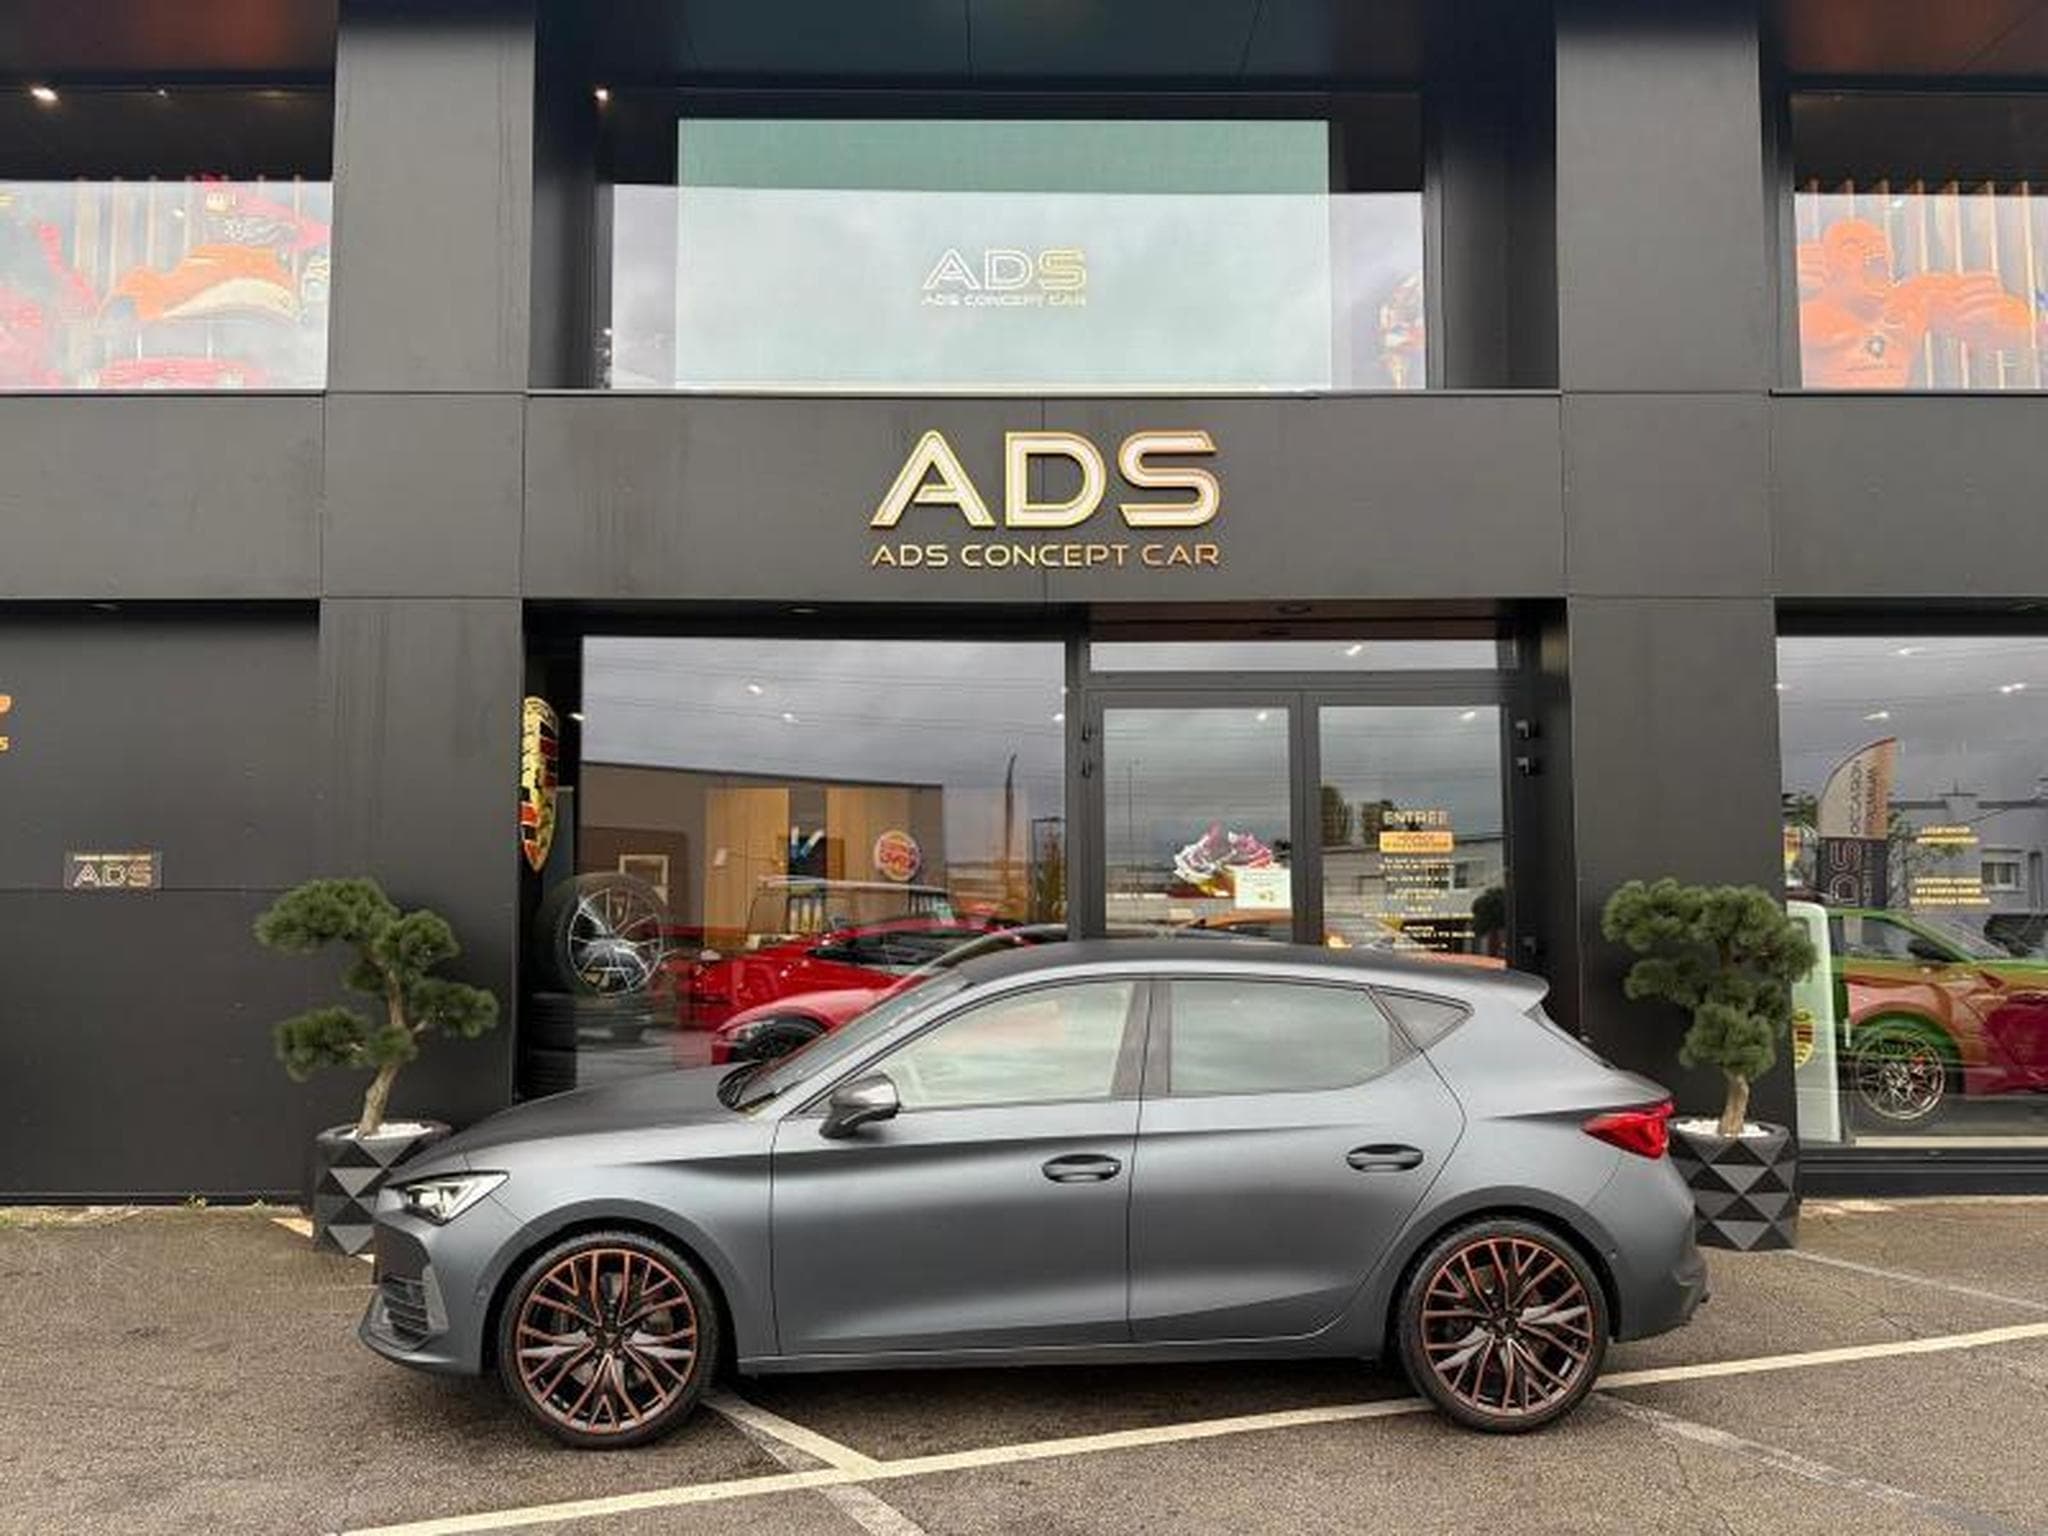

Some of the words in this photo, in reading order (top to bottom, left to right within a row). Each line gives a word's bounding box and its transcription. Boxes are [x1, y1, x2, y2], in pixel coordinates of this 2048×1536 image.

[922, 248, 1087, 290] ADS
[869, 429, 1221, 530] ADS
[870, 543, 949, 568] ADS
[961, 543, 1129, 568] CONCEPT
[1140, 543, 1221, 567] CAR
[73, 862, 152, 888] ADS
